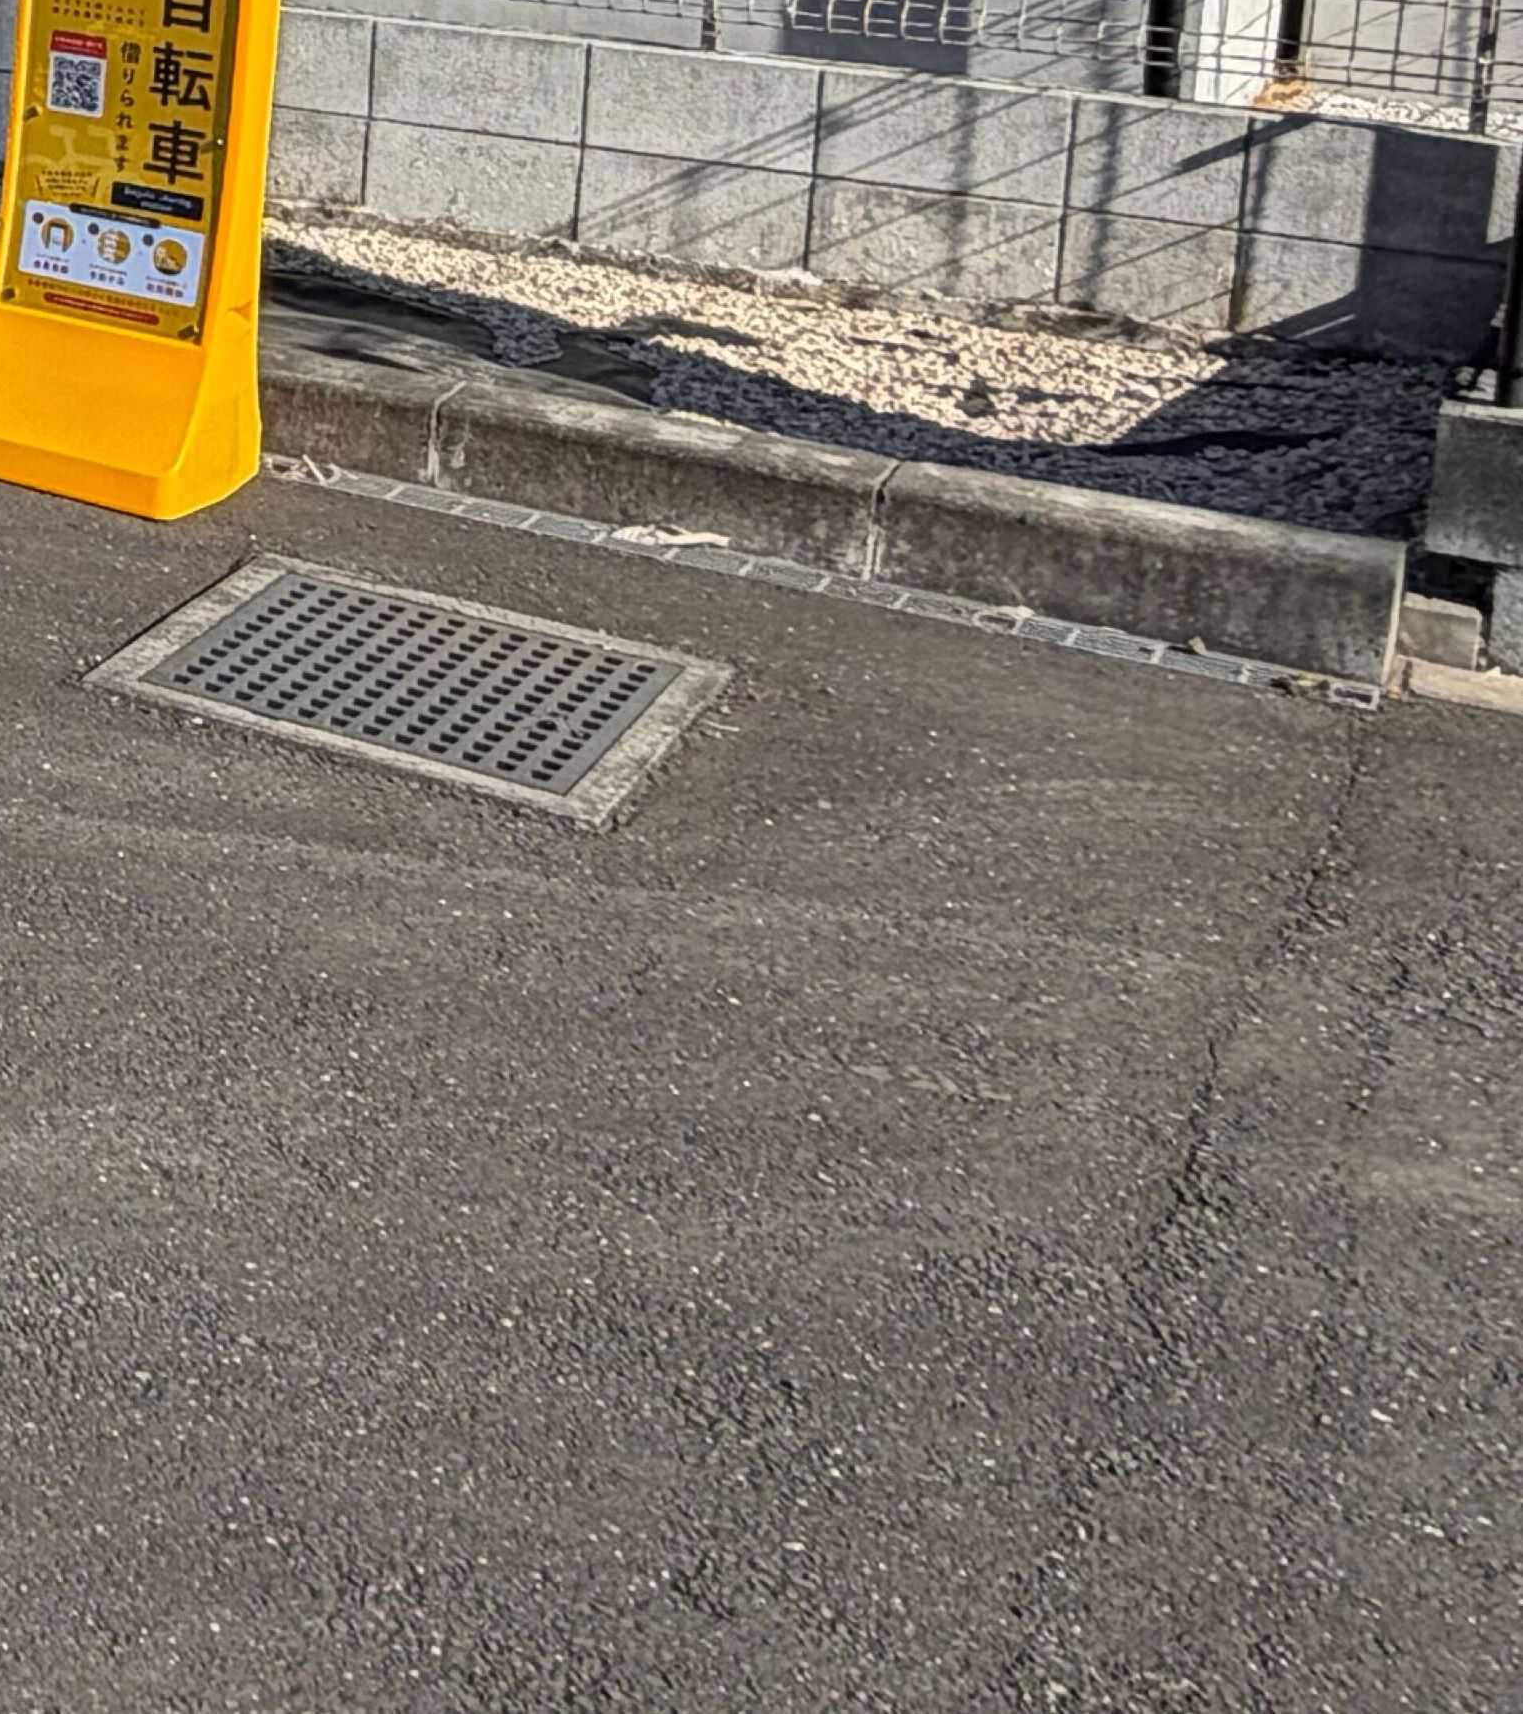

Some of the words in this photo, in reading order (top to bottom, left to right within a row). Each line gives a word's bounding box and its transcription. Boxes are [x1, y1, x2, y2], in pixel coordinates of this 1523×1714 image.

[114, 41, 141, 173] 借りられます
